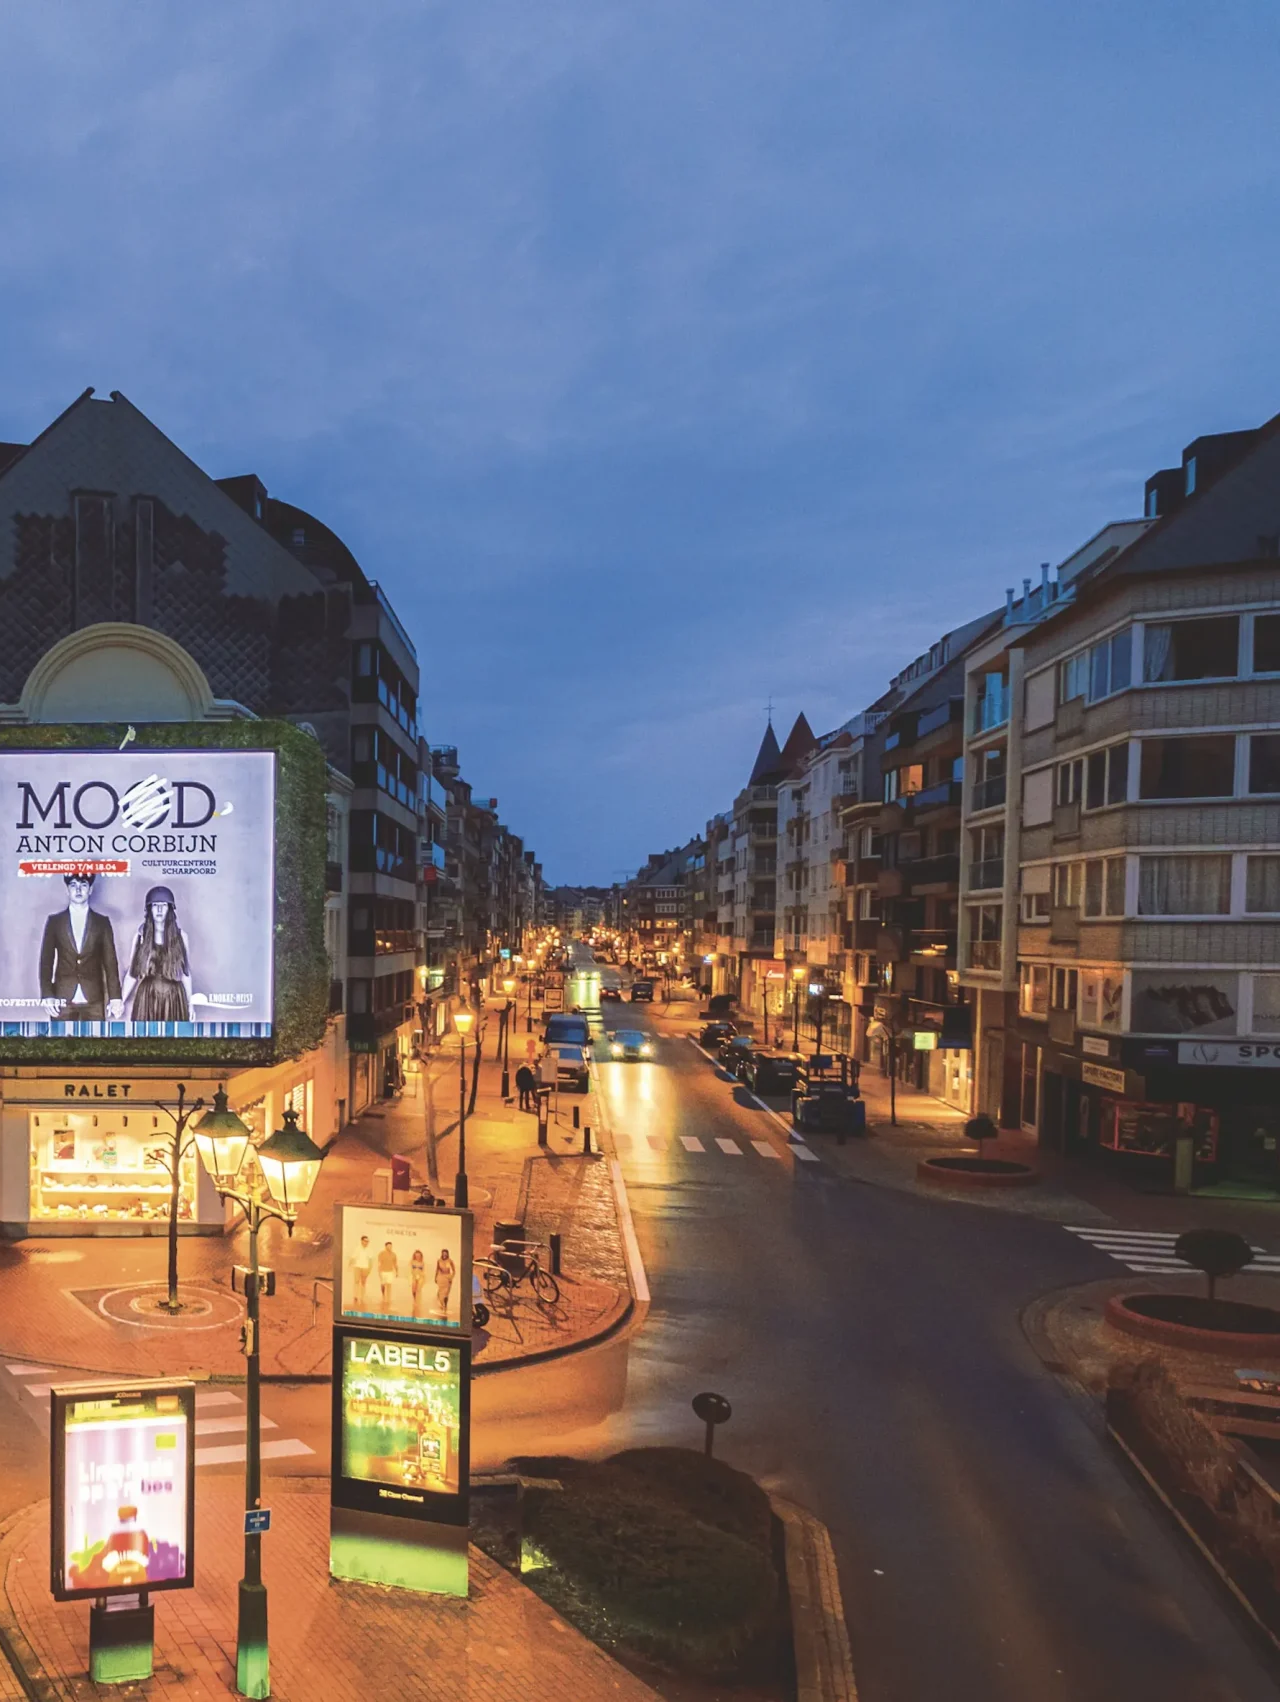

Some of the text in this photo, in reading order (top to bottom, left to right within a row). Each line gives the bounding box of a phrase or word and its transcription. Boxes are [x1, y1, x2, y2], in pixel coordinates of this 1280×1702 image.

[16, 780, 216, 831] MOOD
[16, 835, 217, 853] ANTON CORBIJN
[31, 863, 76, 871] VERLENGD
[77, 863, 94, 872] T/M
[64, 1084, 132, 1097] RALET
